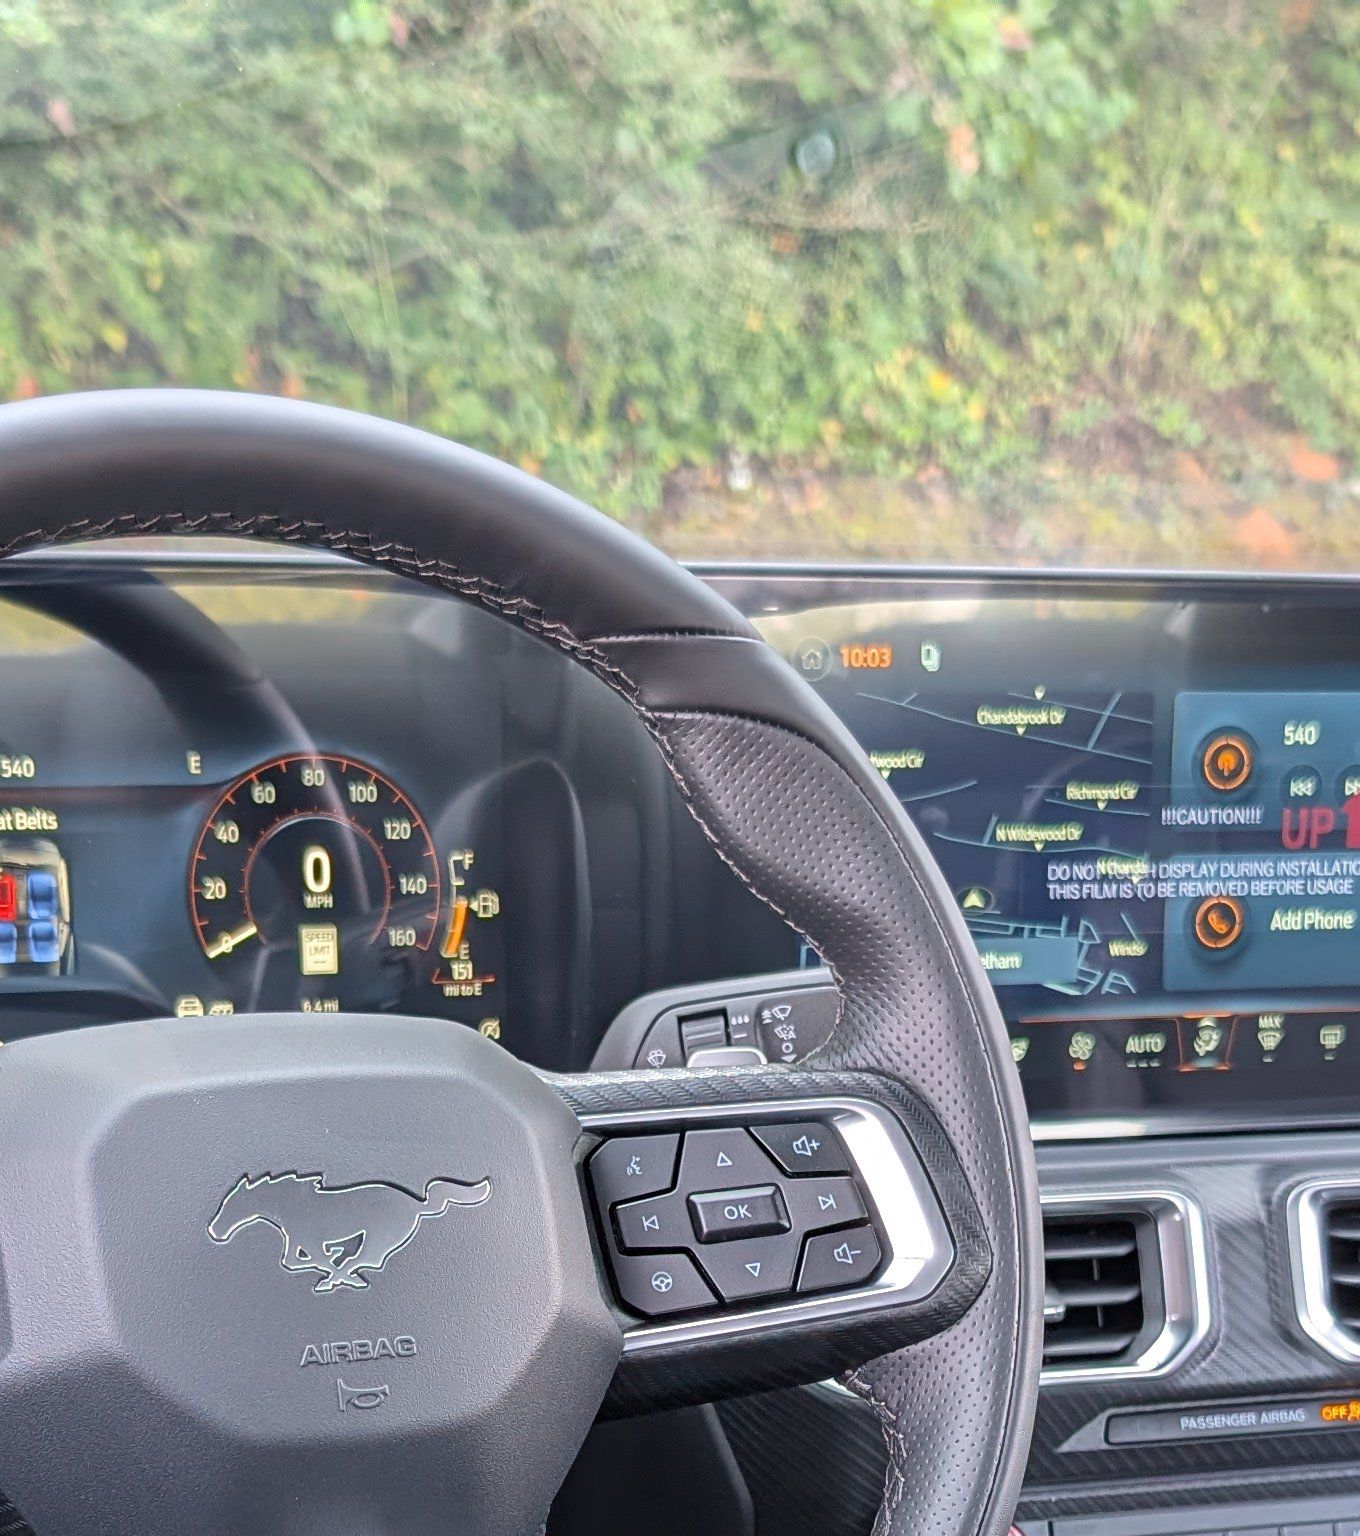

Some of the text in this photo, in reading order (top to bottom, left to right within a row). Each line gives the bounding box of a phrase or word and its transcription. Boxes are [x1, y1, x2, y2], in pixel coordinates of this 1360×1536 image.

[841, 645, 892, 668] 10:03
[1284, 722, 1319, 745] 540
[1, 756, 35, 778] 540
[188, 754, 201, 774] E
[302, 764, 324, 786] 80
[253, 783, 275, 804] 60
[350, 783, 377, 803] 100
[14, 808, 58, 830] Belts
[385, 818, 411, 840] 120
[1282, 808, 1334, 849] UP
[216, 823, 239, 843] 40
[304, 847, 331, 893] 0
[463, 852, 474, 869] F
[1048, 862, 1071, 880] DO
[1159, 862, 1220, 878] DISPLAY
[1221, 861, 1273, 877] DURING
[202, 879, 226, 900] 20
[400, 876, 426, 895] 140
[1047, 879, 1353, 899] THIS FILM IS TO BE REMOVED BEFORE USAGE
[304, 894, 333, 908] MPH
[1270, 909, 1356, 931] Add Phone
[305, 931, 334, 943] SPEED
[389, 927, 416, 947] 160
[459, 942, 470, 960] E
[451, 961, 472, 980] 151
[1126, 1034, 1166, 1053] AUTO
[724, 1204, 752, 1220] OK
[300, 1336, 418, 1366] AIRBAG
[1180, 1405, 1349, 1431] PASSENGER AIRBAG OFF
